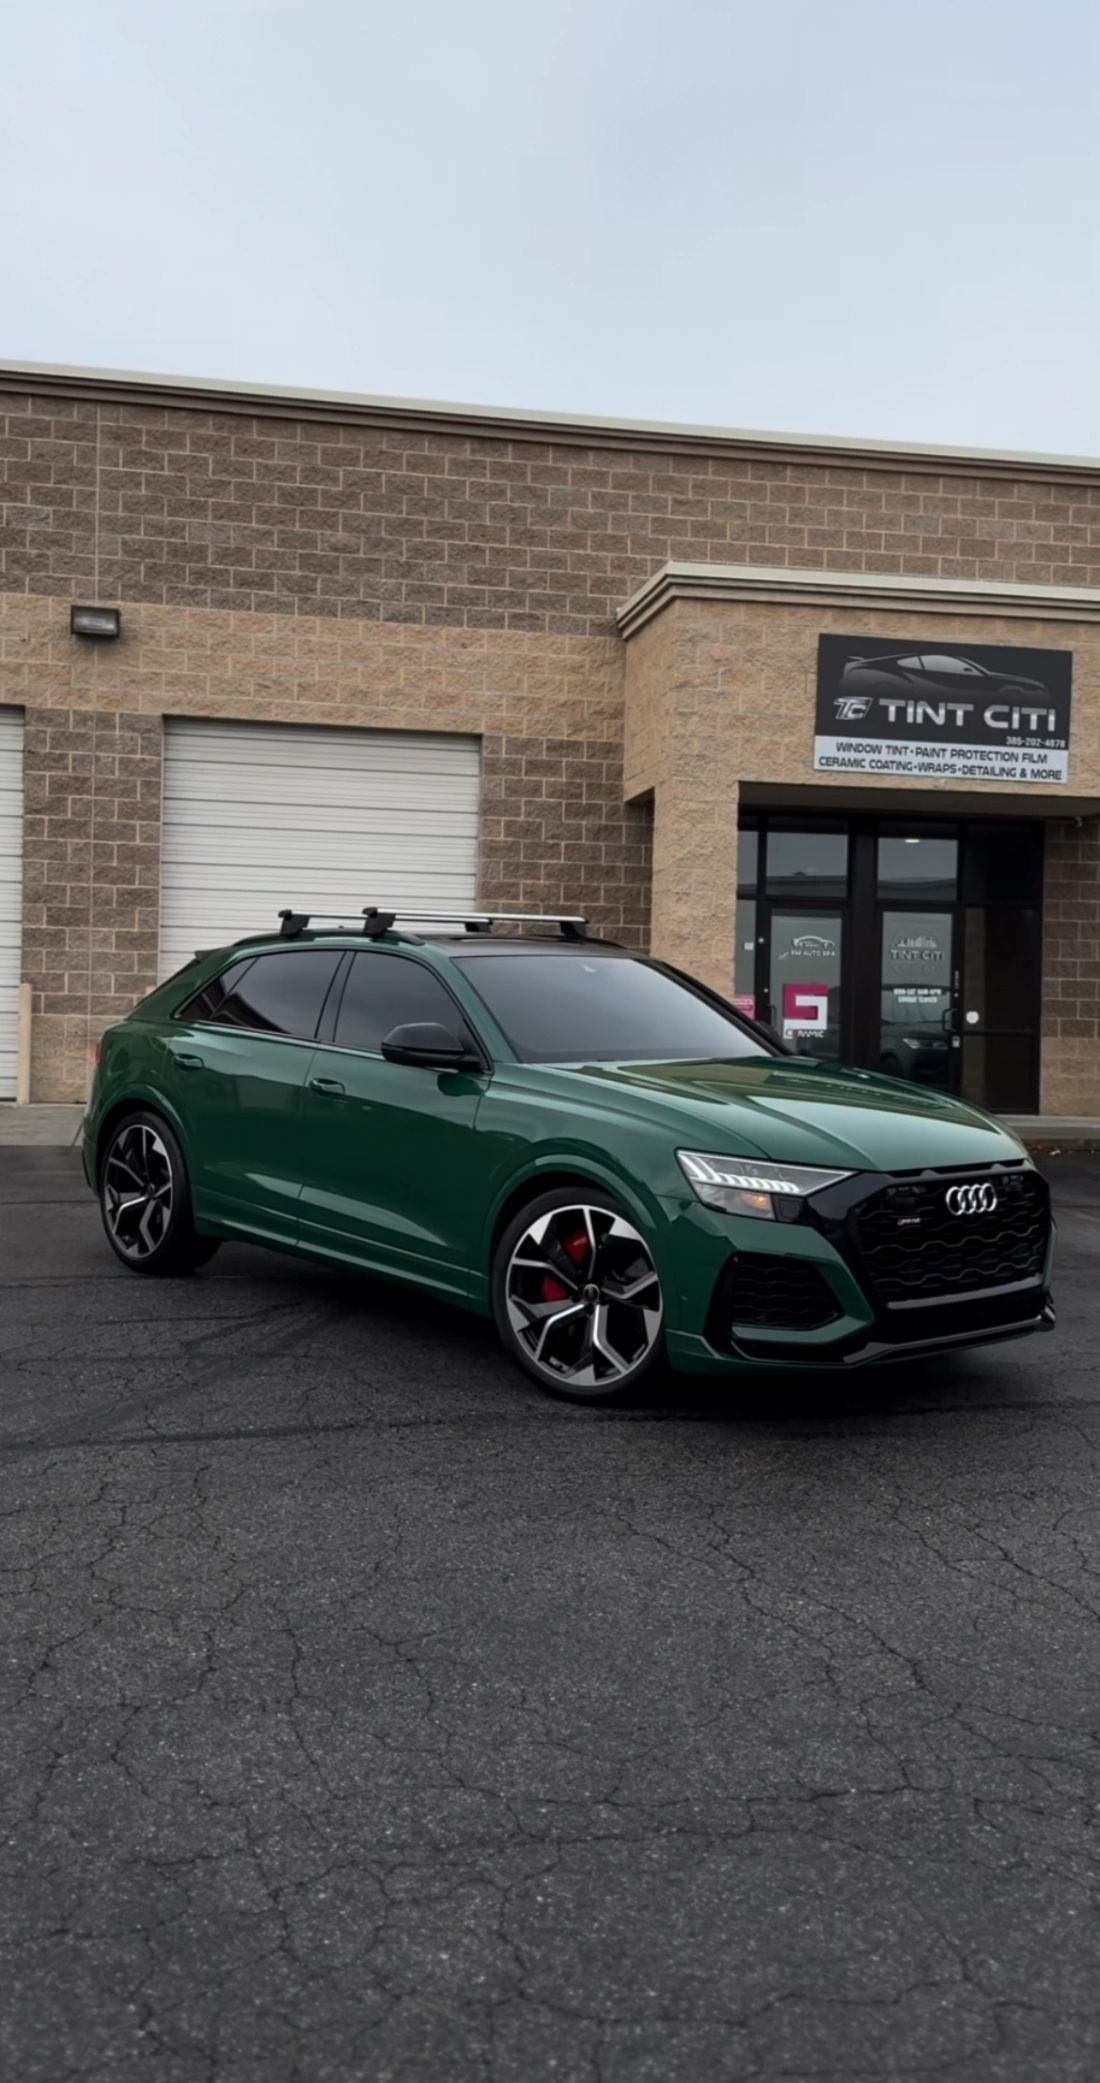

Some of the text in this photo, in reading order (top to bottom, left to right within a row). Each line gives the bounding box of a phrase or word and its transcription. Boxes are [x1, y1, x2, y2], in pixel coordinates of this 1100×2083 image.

[879, 698, 1055, 731] TINT CITI
[836, 742, 882, 754] WINDOW
[950, 749, 1019, 763] PROTECTION
[1022, 752, 1047, 764] FILM
[818, 756, 865, 769] CERAMIC
[1020, 768, 1027, 778] &
[1030, 768, 1062, 780] MORE
